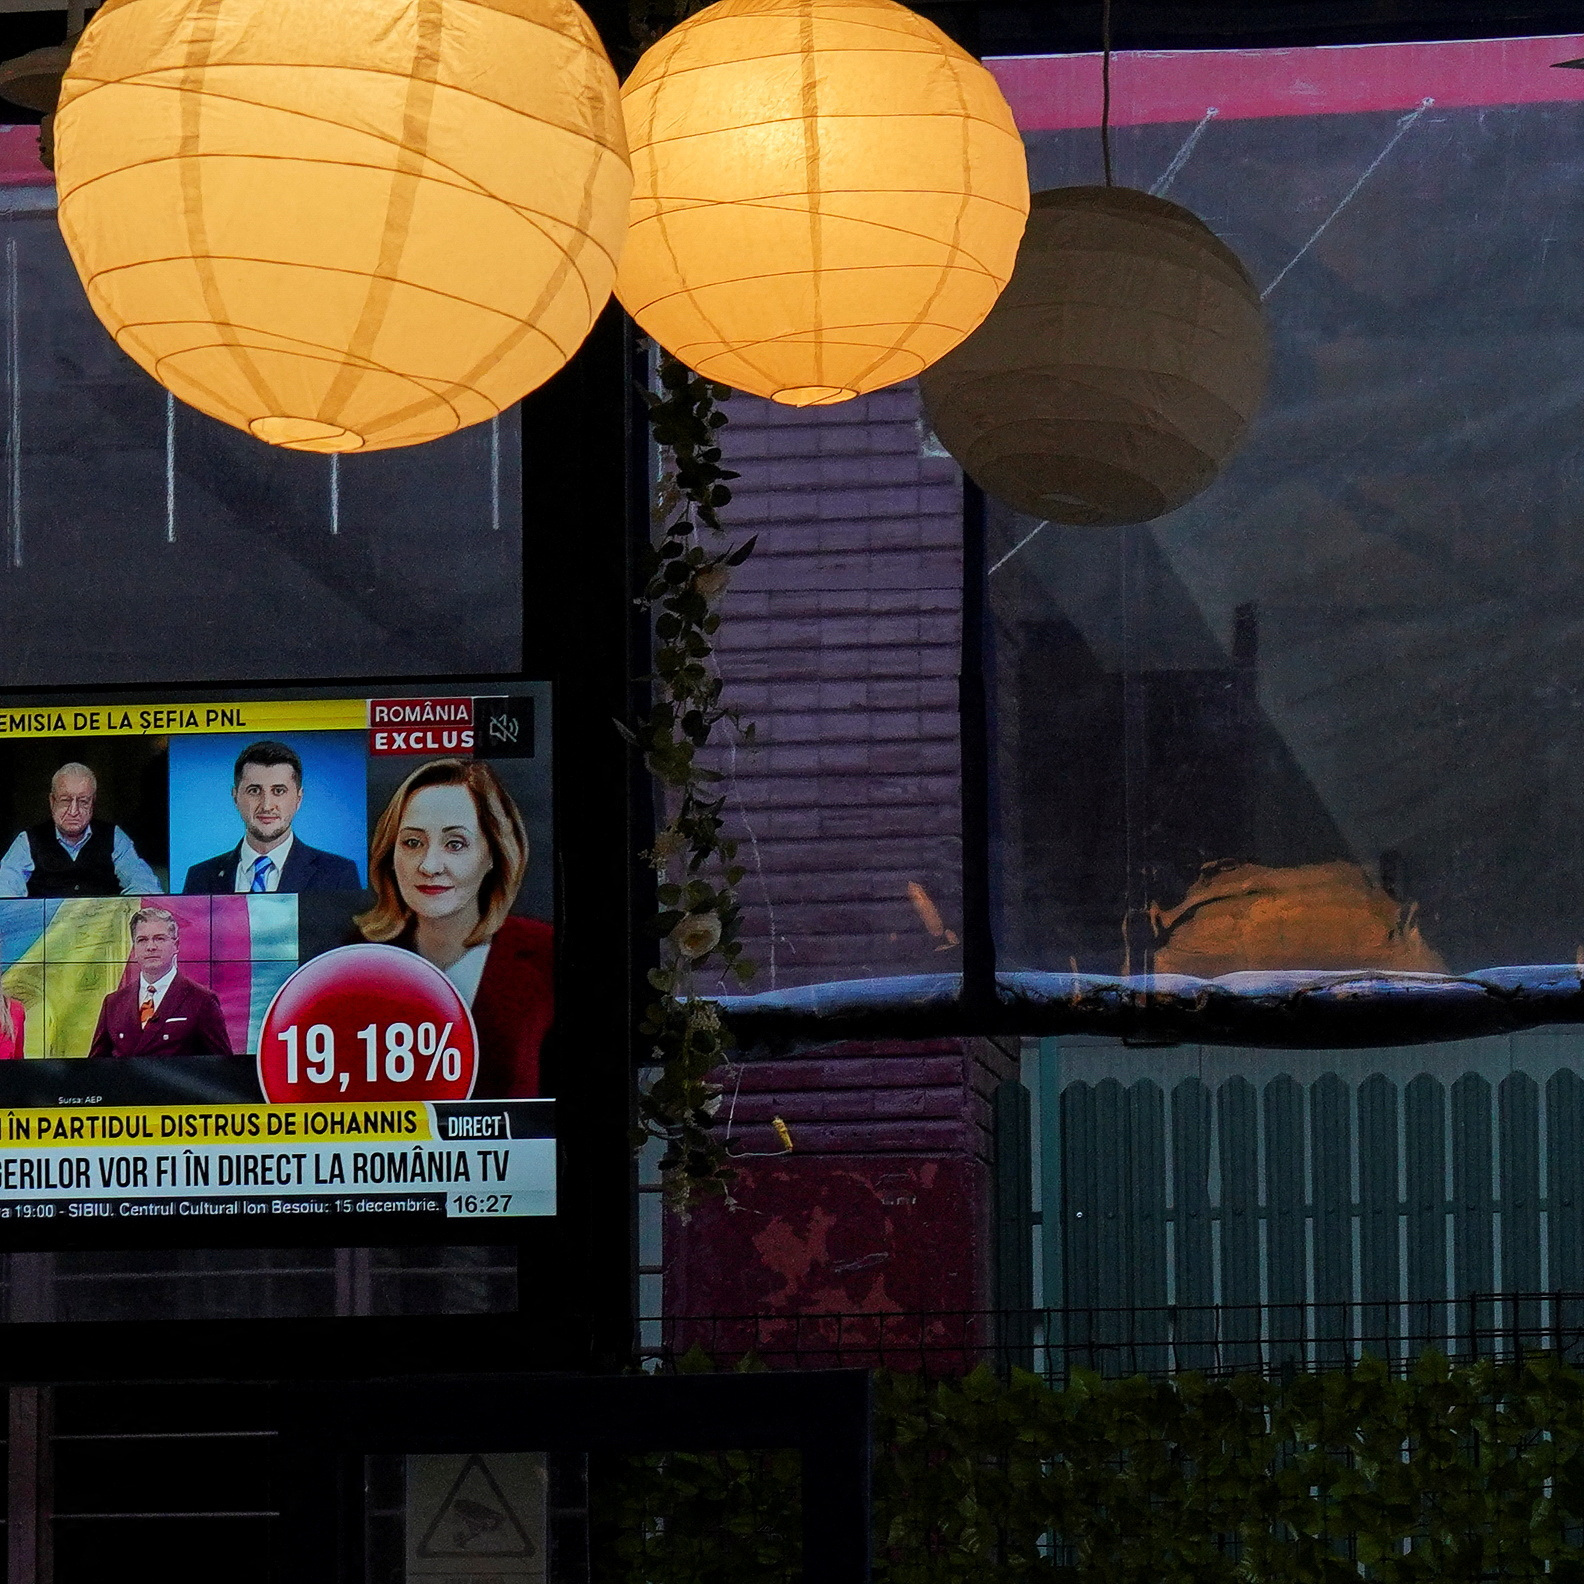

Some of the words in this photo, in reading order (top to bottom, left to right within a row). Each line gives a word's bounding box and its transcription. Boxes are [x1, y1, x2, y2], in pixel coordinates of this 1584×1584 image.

[73, 712, 101, 731] DE
[107, 711, 133, 730] LA
[139, 709, 199, 736] ȘEFIA
[206, 708, 247, 728] PNL
[375, 701, 469, 723] ROMÂNIA
[374, 730, 474, 750] EXCLUS
[276, 1020, 462, 1094] 19,18%
[84, 1095, 103, 1104] AEP
[7, 1110, 30, 1141] ÎN
[37, 1115, 154, 1140] PARTIDUL
[160, 1112, 261, 1138] DISTRUS
[267, 1112, 296, 1136] DE
[303, 1110, 417, 1135] IOHANNIS
[447, 1115, 502, 1137] DIRECT
[98, 1156, 148, 1189] VOR
[156, 1155, 177, 1188] FI
[182, 1148, 210, 1187] ÎN
[217, 1153, 307, 1186] DIRECT
[314, 1152, 345, 1185] LA
[352, 1144, 471, 1184] ROMÂNIA
[476, 1150, 510, 1182] TV
[15, 1204, 55, 1218] 19:00
[119, 1202, 174, 1216] Centrul
[179, 1201, 238, 1216] Cultural
[242, 1200, 266, 1215] Ion
[271, 1199, 330, 1214] Besoiu:
[334, 1199, 352, 1213] 15
[453, 1194, 513, 1214] 16:27
